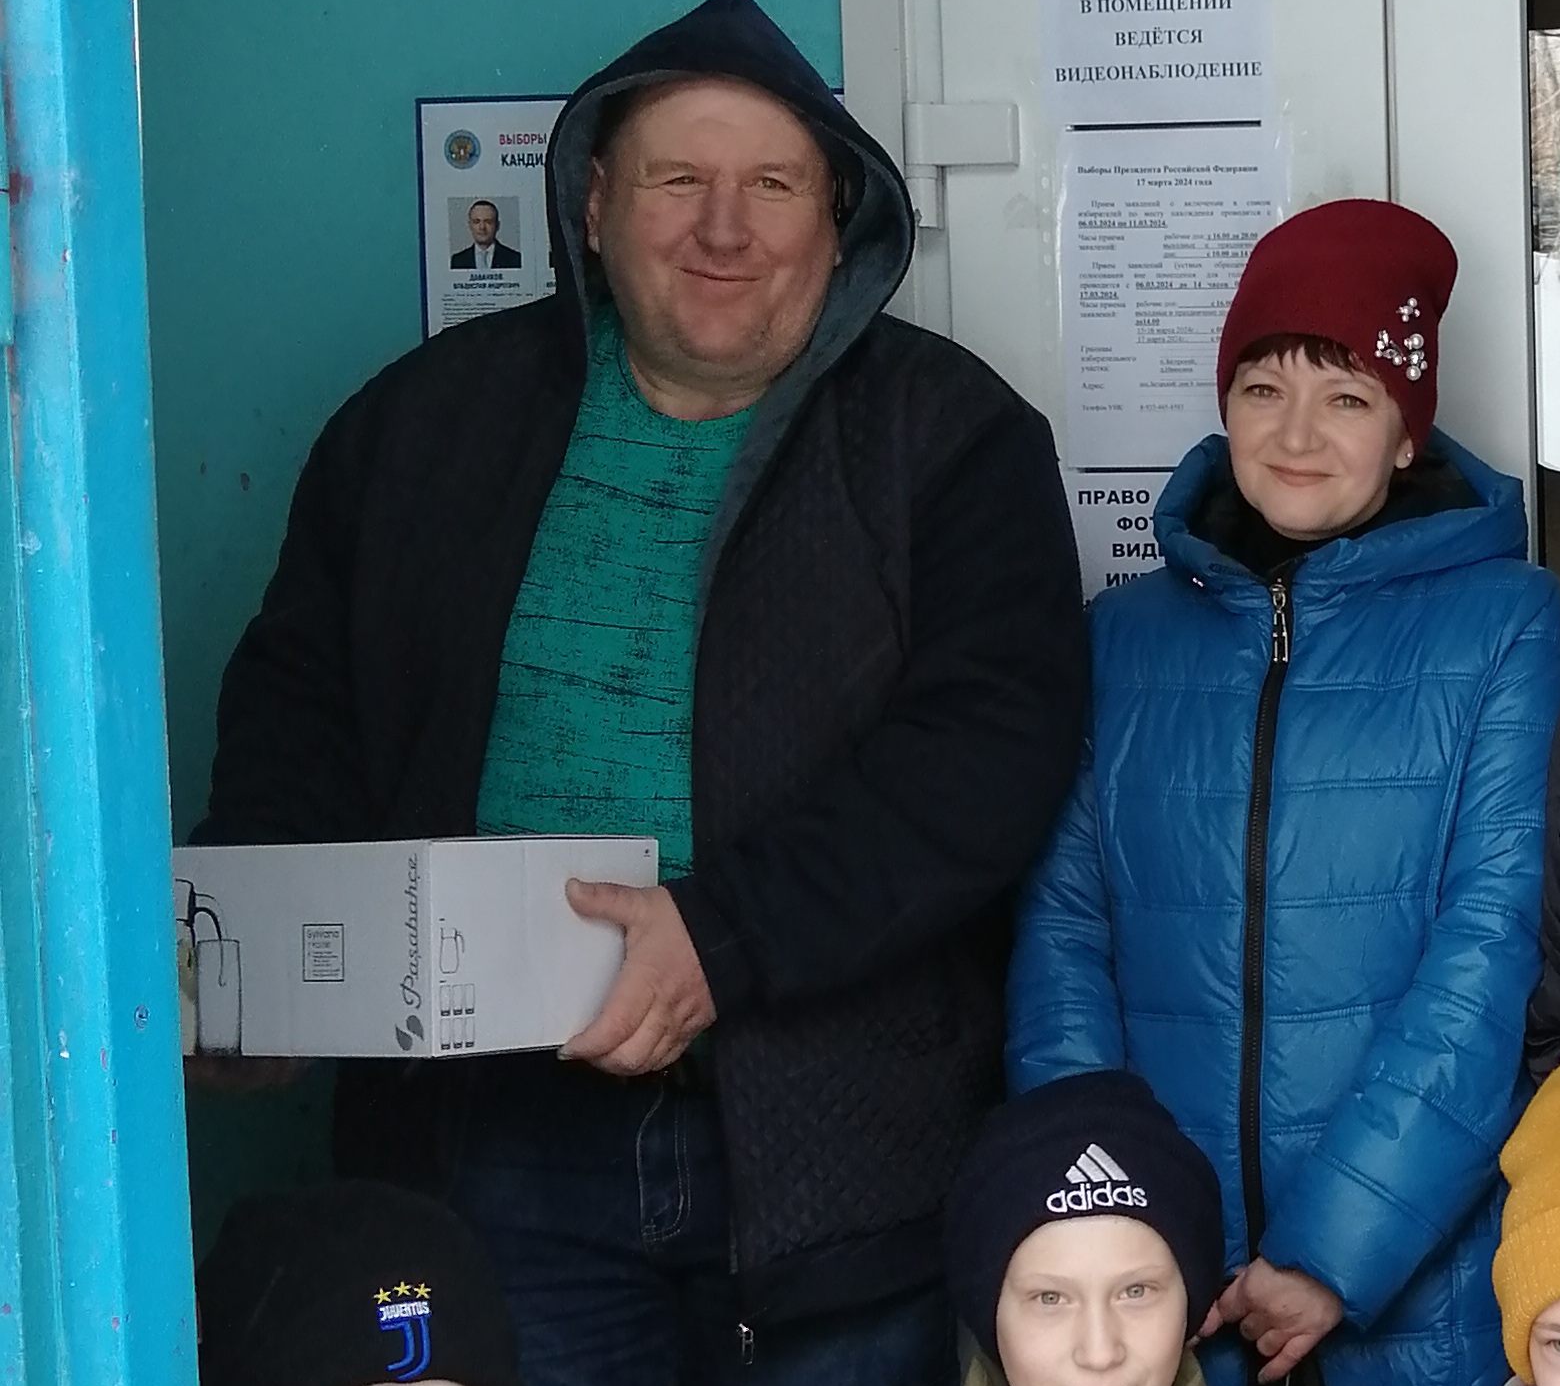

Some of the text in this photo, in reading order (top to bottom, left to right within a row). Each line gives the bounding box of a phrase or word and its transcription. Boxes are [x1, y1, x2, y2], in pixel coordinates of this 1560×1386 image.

[1080, 0, 1092, 14] В
[1115, 27, 1203, 47] ВЕДЁТСЯ
[1055, 62, 1262, 84] ВИДЕОНАБЛЮДЕНИЕ
[499, 133, 547, 145] ВЫБОРЫ
[501, 153, 546, 168] КАНДИ
[1078, 489, 1150, 505] ПРАВО
[1117, 516, 1154, 531] ФО
[1112, 543, 1165, 561] ВИД
[1046, 1181, 1148, 1213] adidas
[379, 1301, 430, 1322] JUVENTUS
